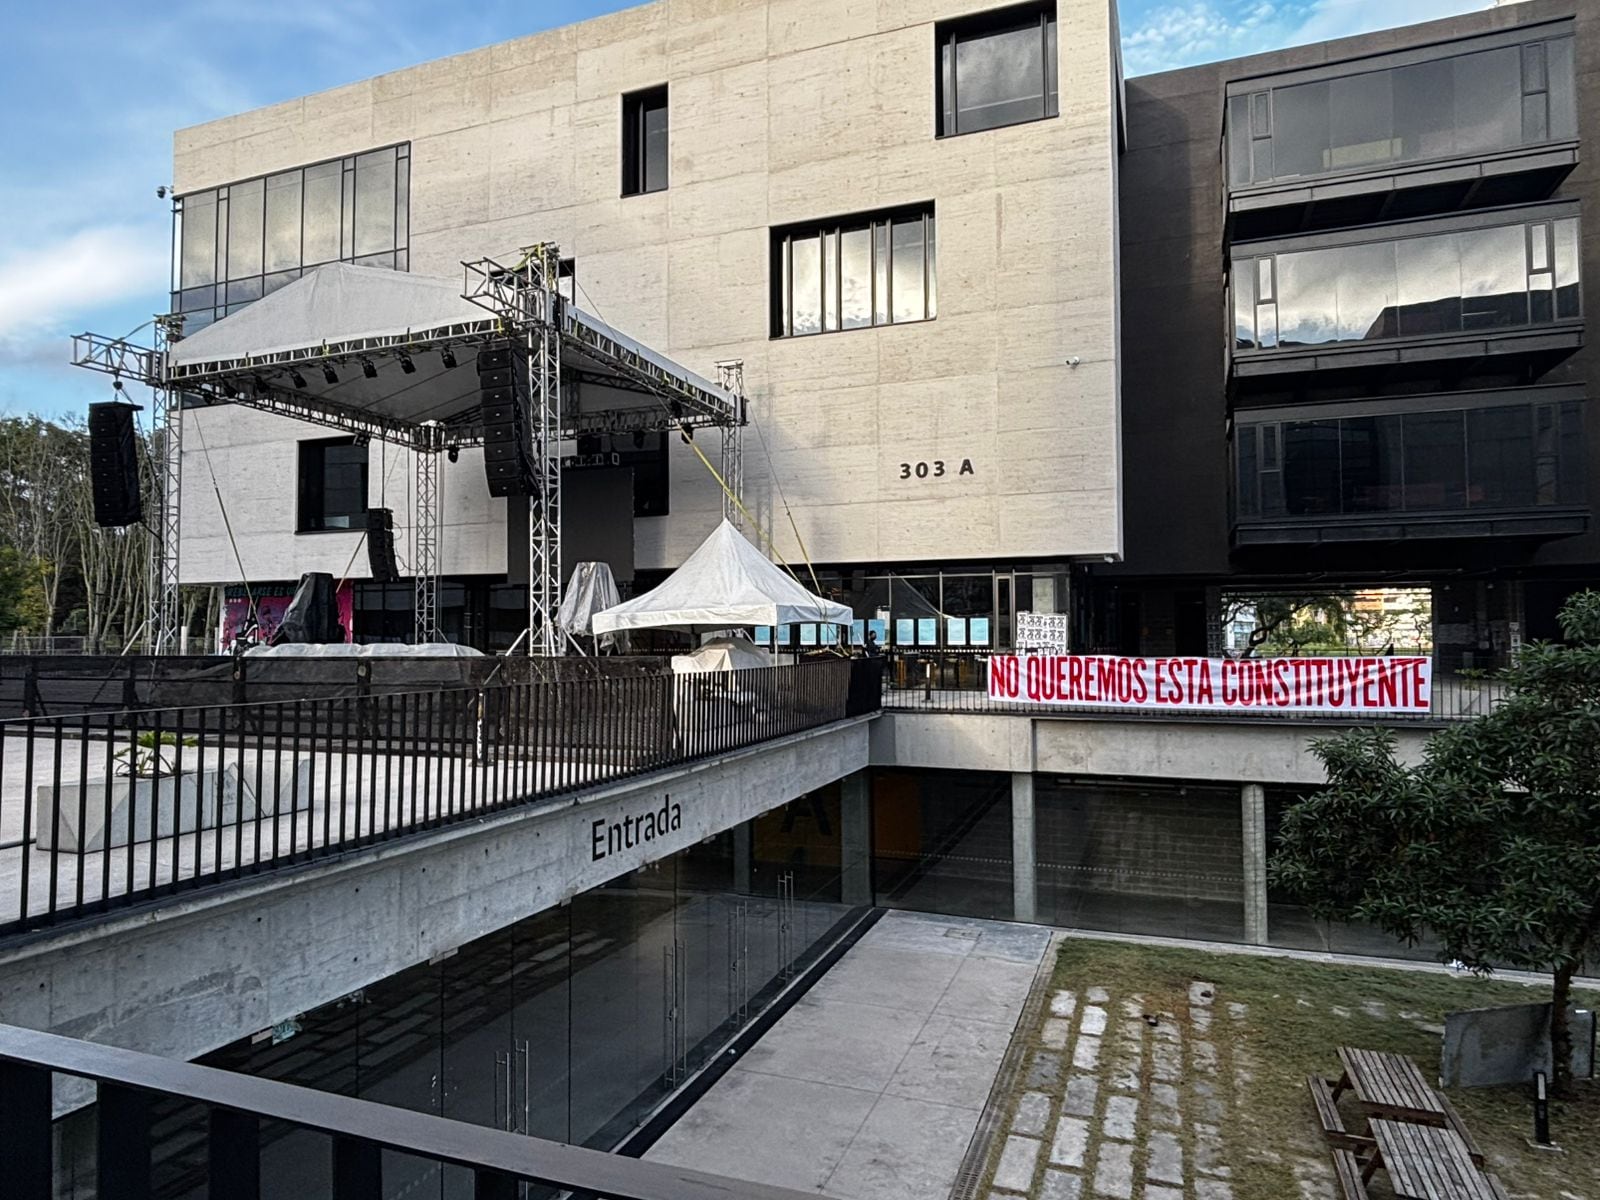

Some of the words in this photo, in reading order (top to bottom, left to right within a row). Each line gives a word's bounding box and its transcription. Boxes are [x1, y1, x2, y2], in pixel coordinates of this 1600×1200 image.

[900, 461, 945, 479] 303
[959, 459, 974, 475] A
[990, 656, 1019, 698] NO
[1027, 656, 1148, 703] QUEREMOS
[1155, 658, 1214, 704] ESTA
[1221, 658, 1429, 707] CONSTITUYENTE
[592, 794, 681, 861] Entrada
